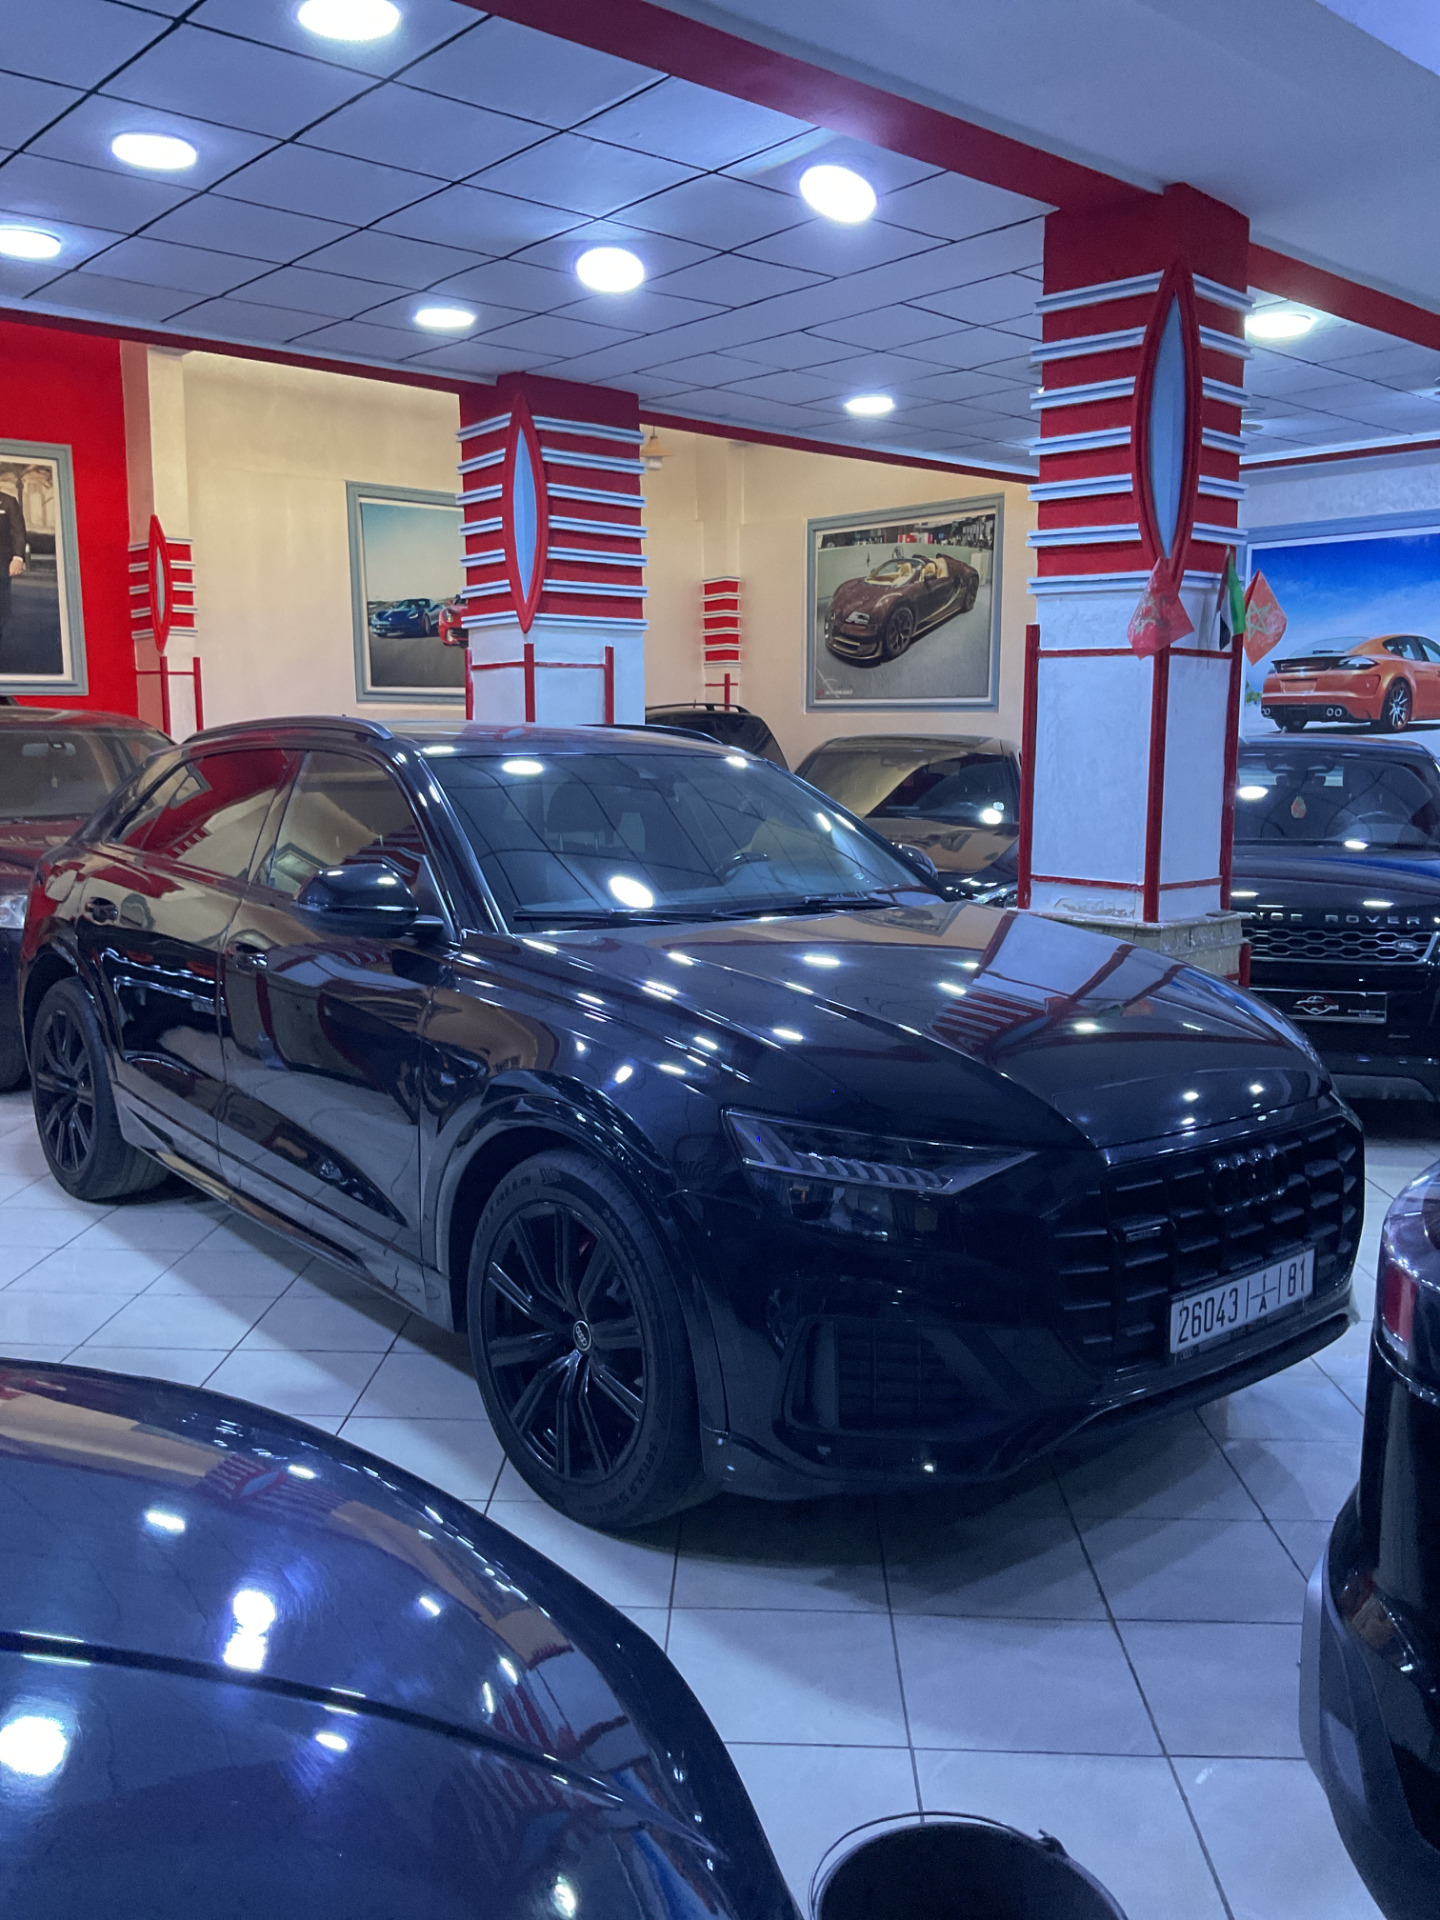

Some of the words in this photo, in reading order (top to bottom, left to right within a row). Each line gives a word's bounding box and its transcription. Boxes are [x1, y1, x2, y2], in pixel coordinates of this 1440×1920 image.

[1325, 914, 1420, 925] ROVER
[1178, 1287, 1239, 1344] 26043
[1287, 1259, 1306, 1298] 81
[1258, 1295, 1268, 1314] A
